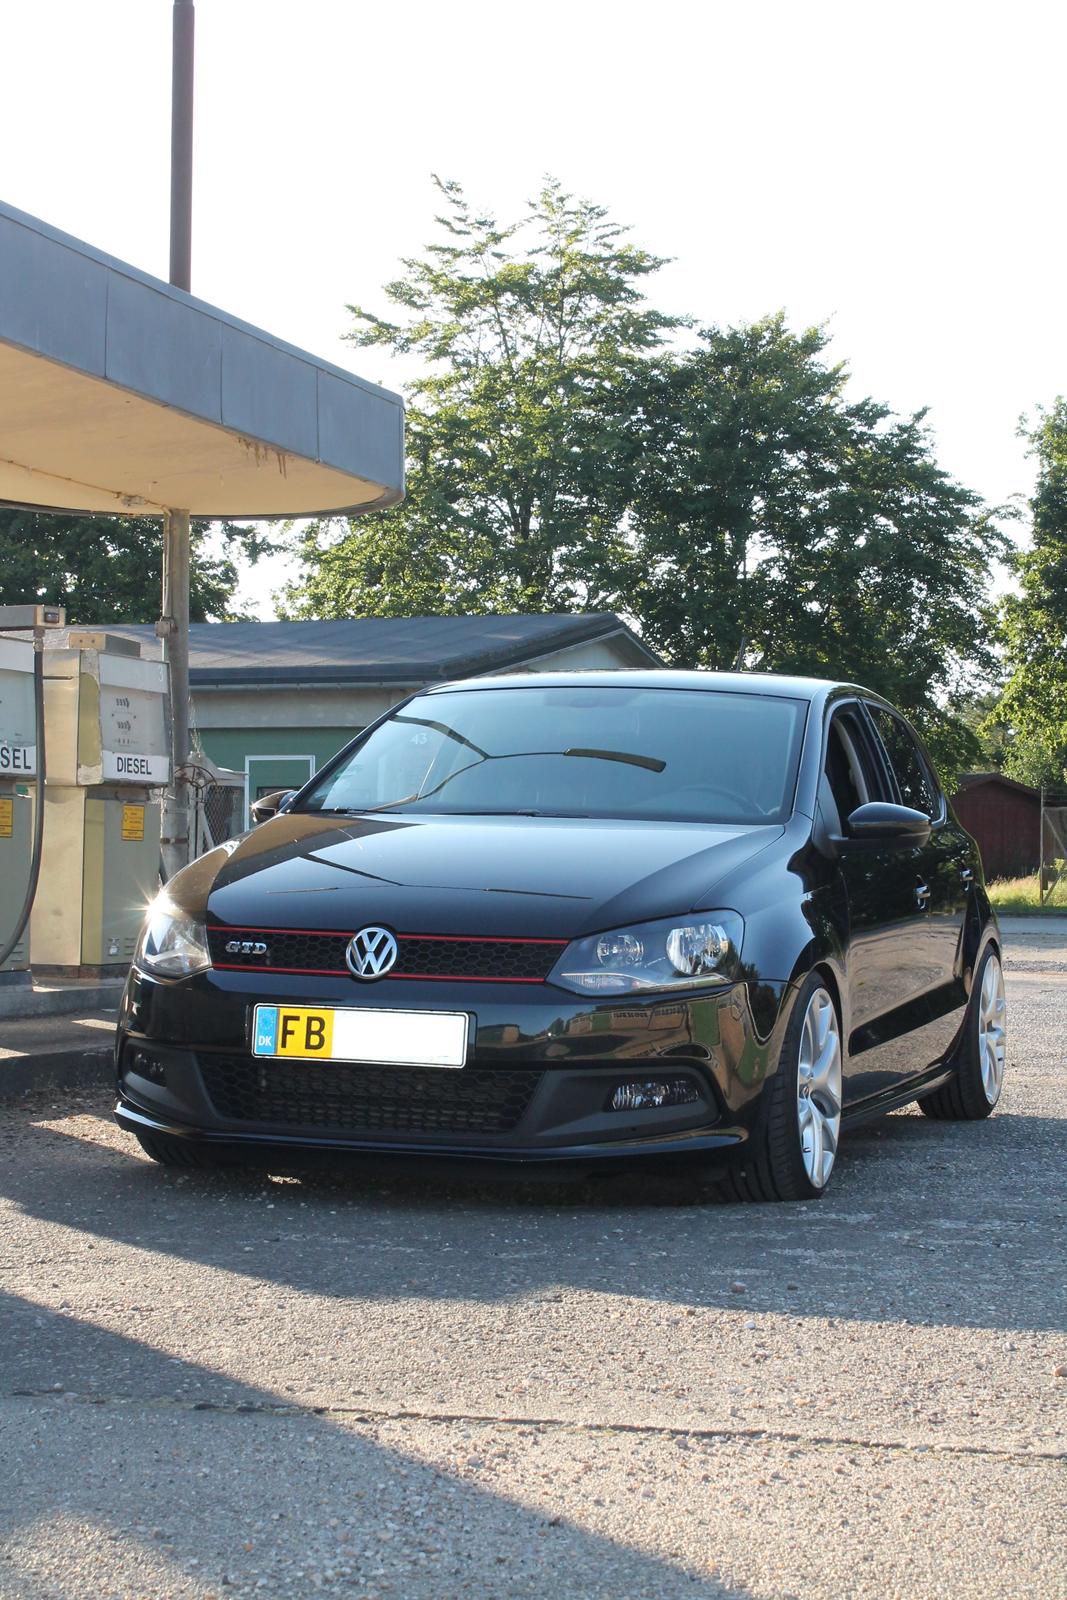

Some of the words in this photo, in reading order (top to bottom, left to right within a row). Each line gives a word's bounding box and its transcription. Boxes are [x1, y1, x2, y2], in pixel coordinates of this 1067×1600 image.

[0, 747, 32, 769] SEL
[117, 757, 152, 775] DIESEL
[225, 941, 267, 955] GTD
[258, 1035, 272, 1047] DK
[280, 1015, 326, 1051] FB
